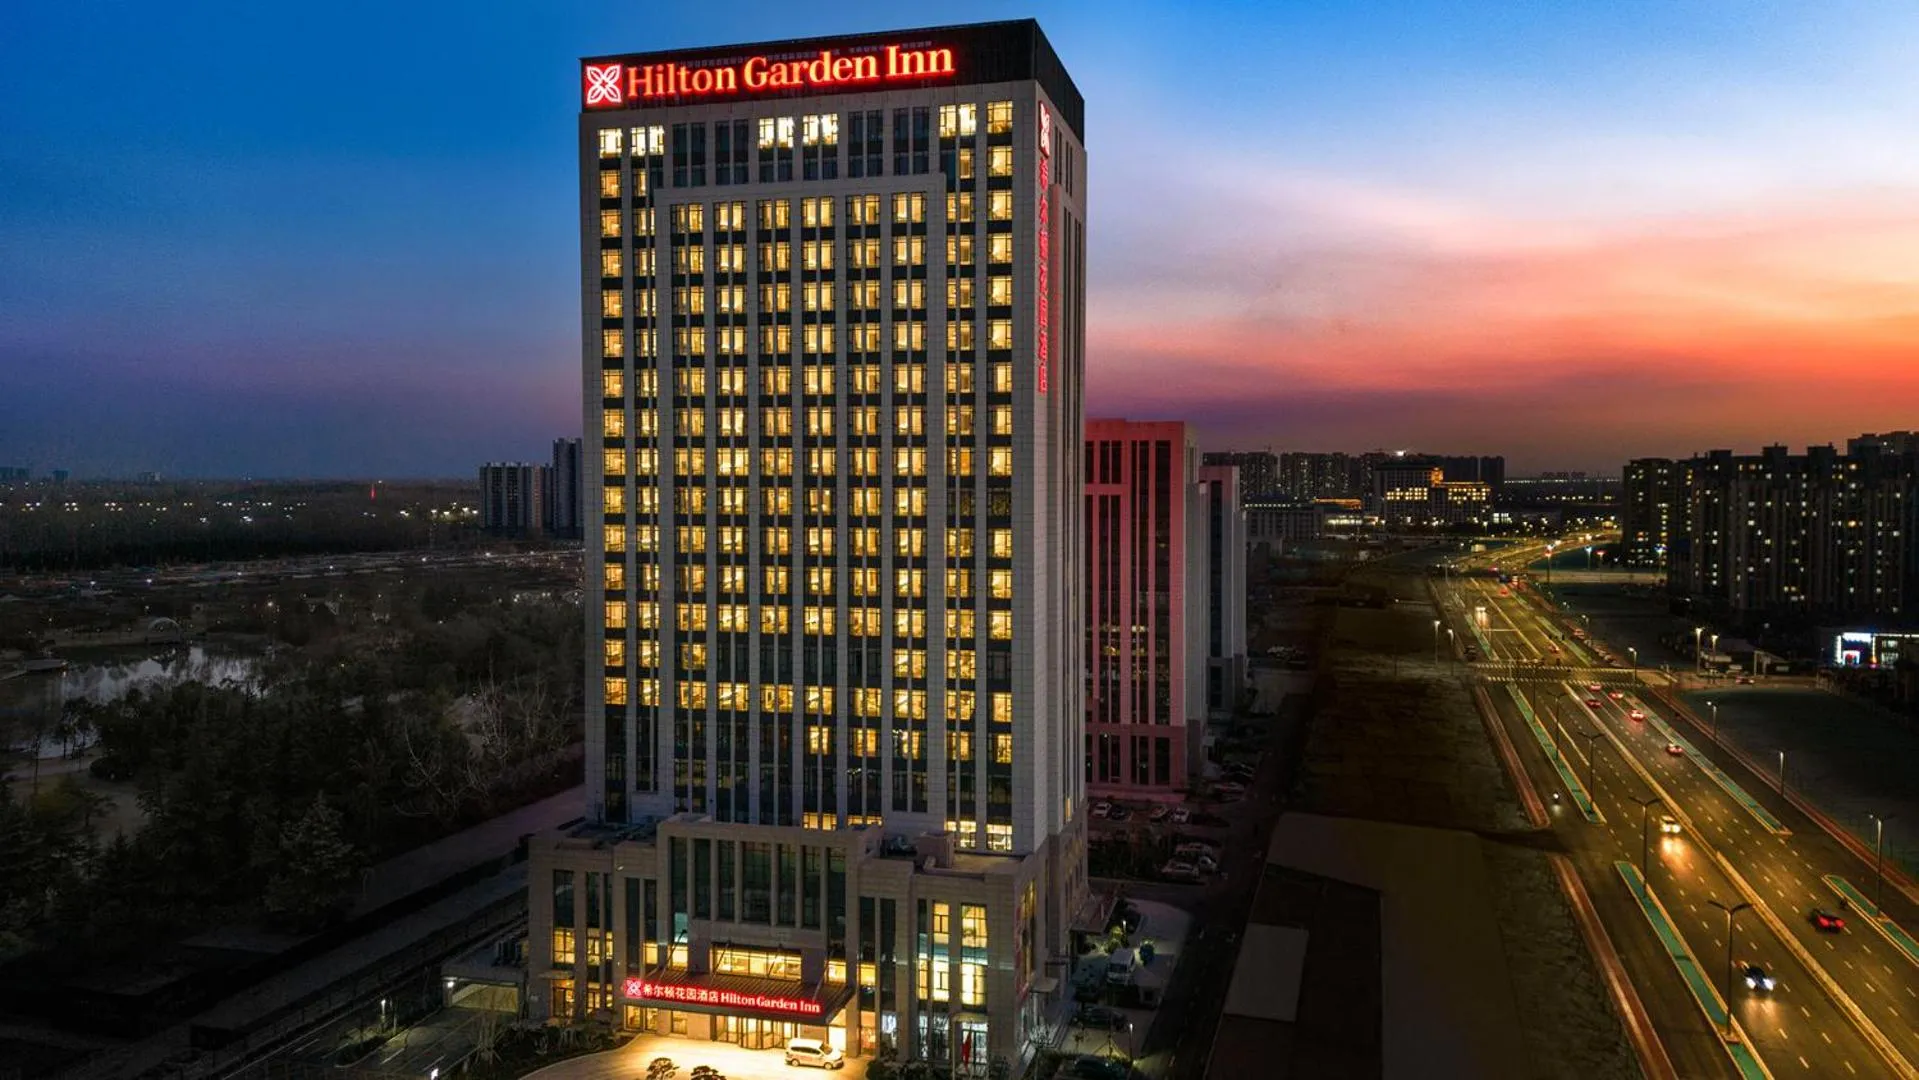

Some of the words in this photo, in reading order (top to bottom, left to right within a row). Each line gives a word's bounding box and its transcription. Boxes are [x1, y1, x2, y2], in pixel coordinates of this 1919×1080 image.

[627, 62, 738, 97] Hilton
[743, 50, 880, 88] Garden
[884, 45, 956, 78] Inn
[643, 983, 719, 1004] 希尔顿花园酒店
[720, 993, 755, 1006] Hilton
[756, 996, 798, 1011] Garden
[799, 1000, 821, 1014] Inn
